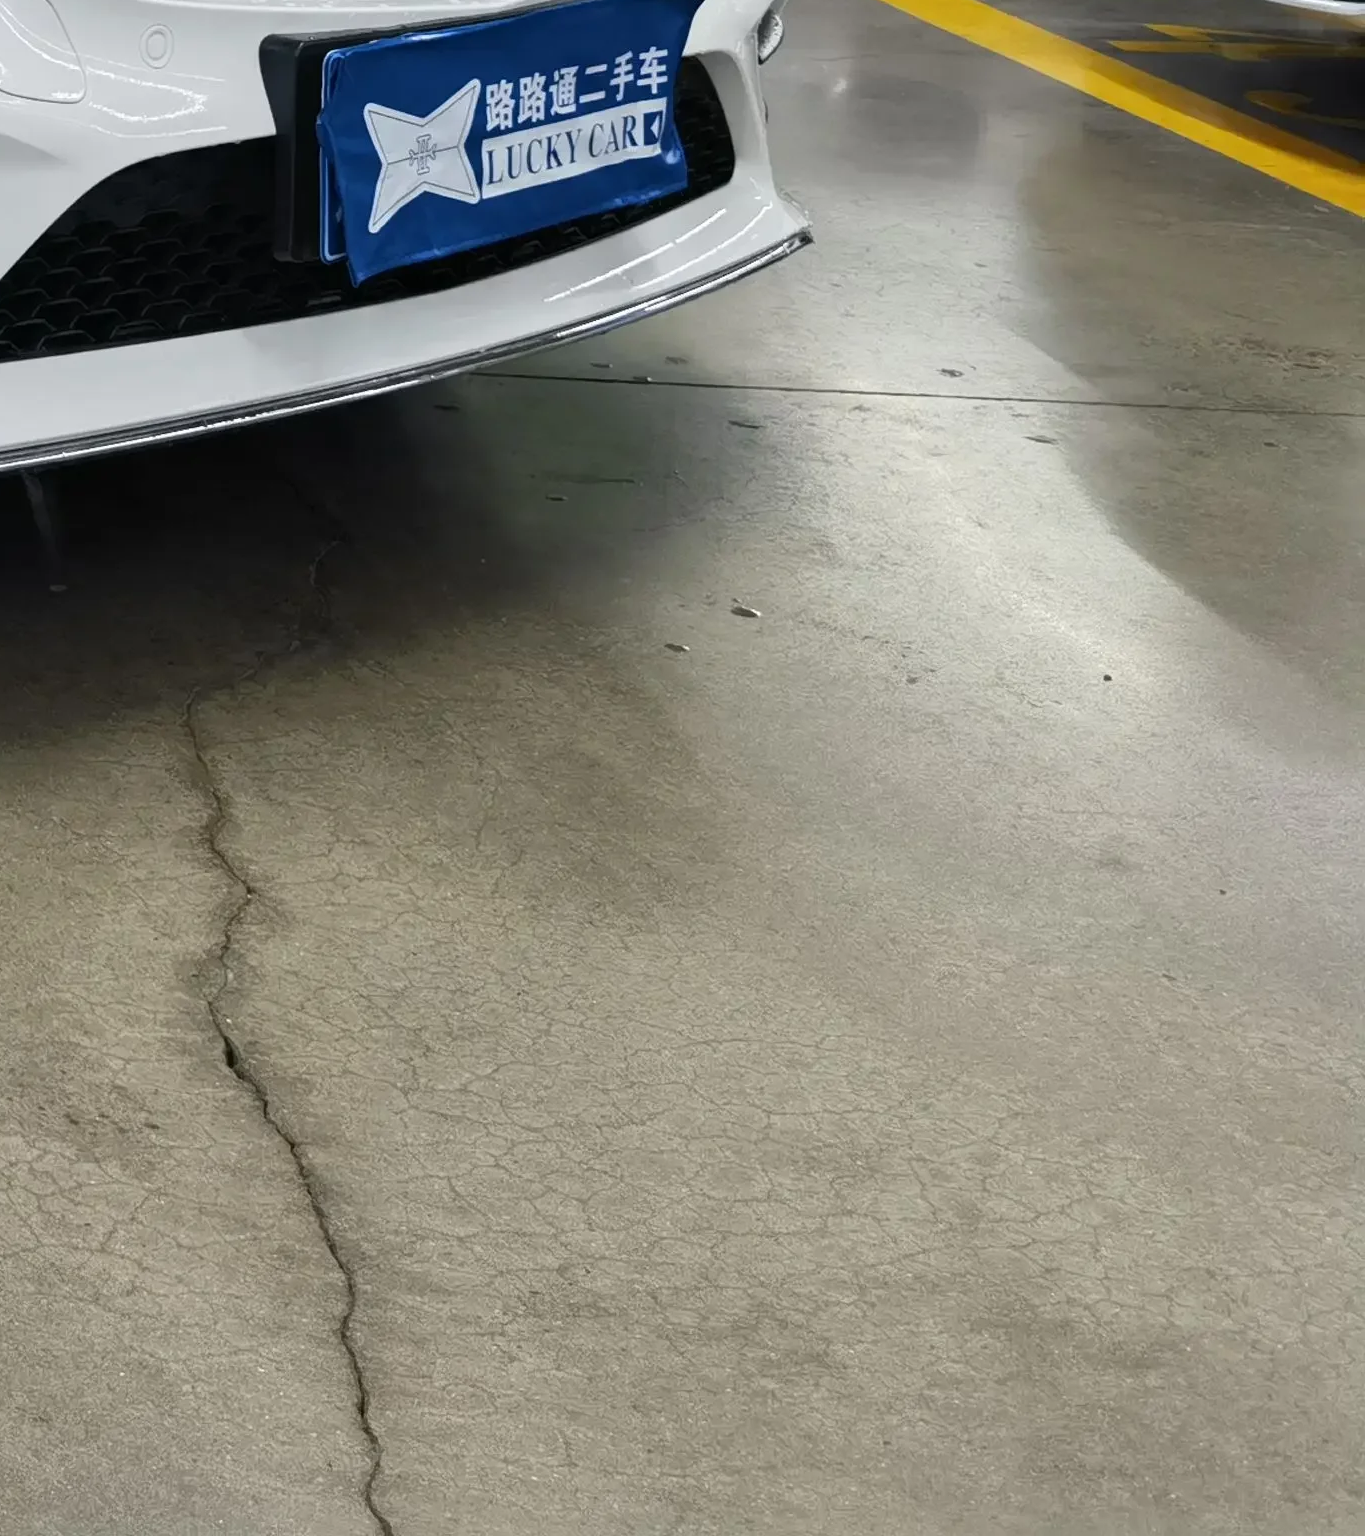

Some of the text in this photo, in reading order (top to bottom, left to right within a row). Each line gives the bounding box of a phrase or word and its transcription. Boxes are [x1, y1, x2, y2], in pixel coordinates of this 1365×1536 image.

[485, 46, 668, 132] 路路通二手车
[485, 114, 637, 185] LUCKY CAR
